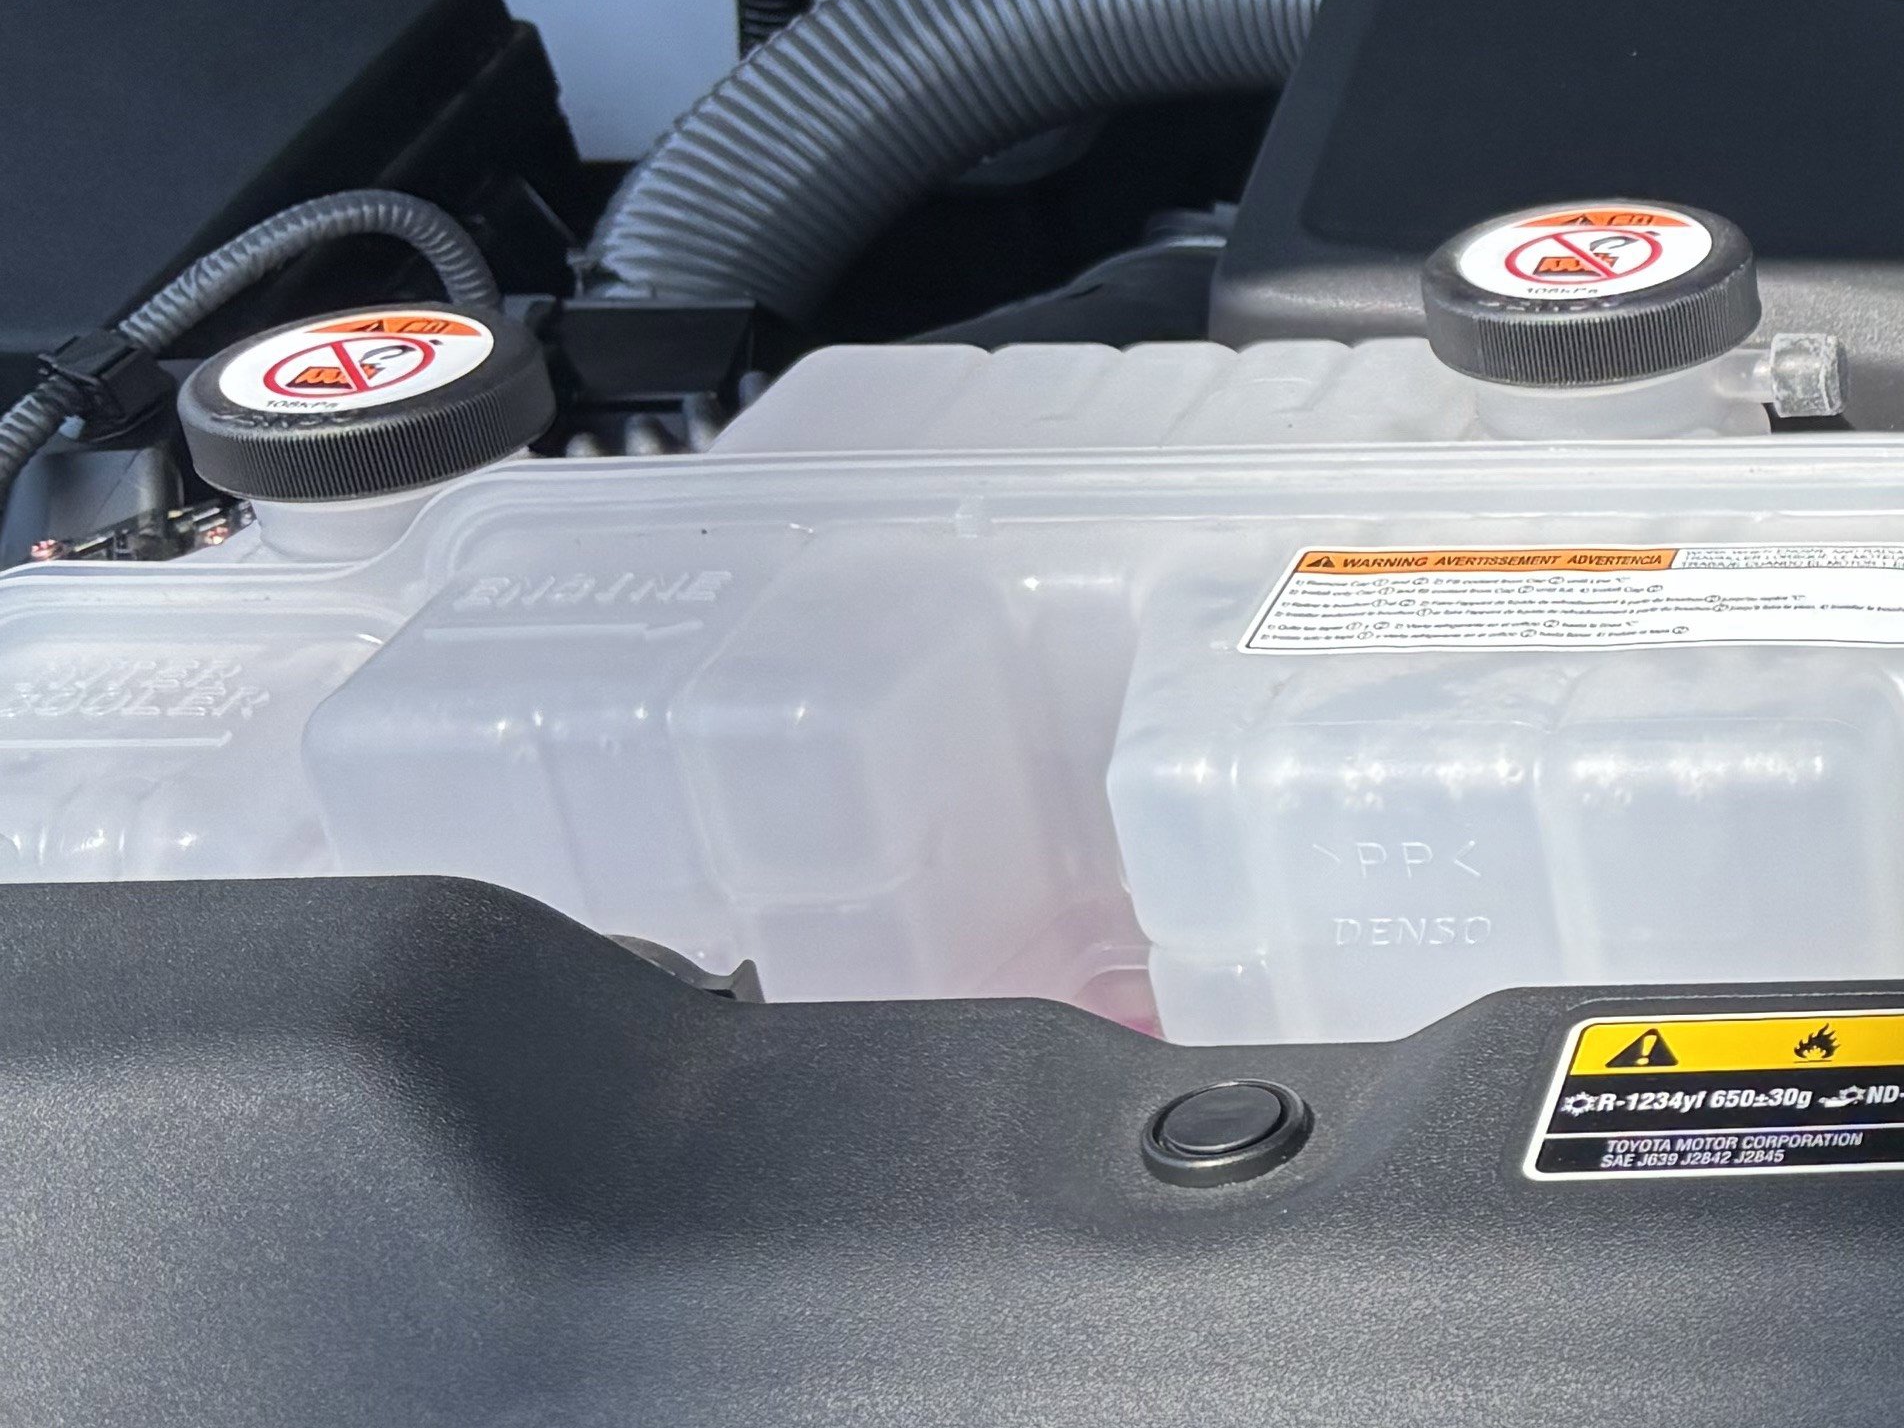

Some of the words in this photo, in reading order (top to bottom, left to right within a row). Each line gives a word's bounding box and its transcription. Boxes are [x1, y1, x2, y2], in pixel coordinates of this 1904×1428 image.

[1342, 557, 1428, 568] WARNING
[1435, 555, 1560, 566] AVERTISSEMENT
[1567, 554, 1662, 565] ADVERTENCIA
[1334, 916, 1491, 946] DENSO
[1597, 1089, 1706, 1113] R-1234yf
[1710, 1087, 1813, 1110] 650±30g
[1606, 1136, 1672, 1154] TOYOTA
[1676, 1134, 1738, 1152] MOTOR
[1741, 1131, 1864, 1150] CORPORATION
[1600, 1153, 1635, 1168] SAE
[1637, 1152, 1676, 1167] J639
